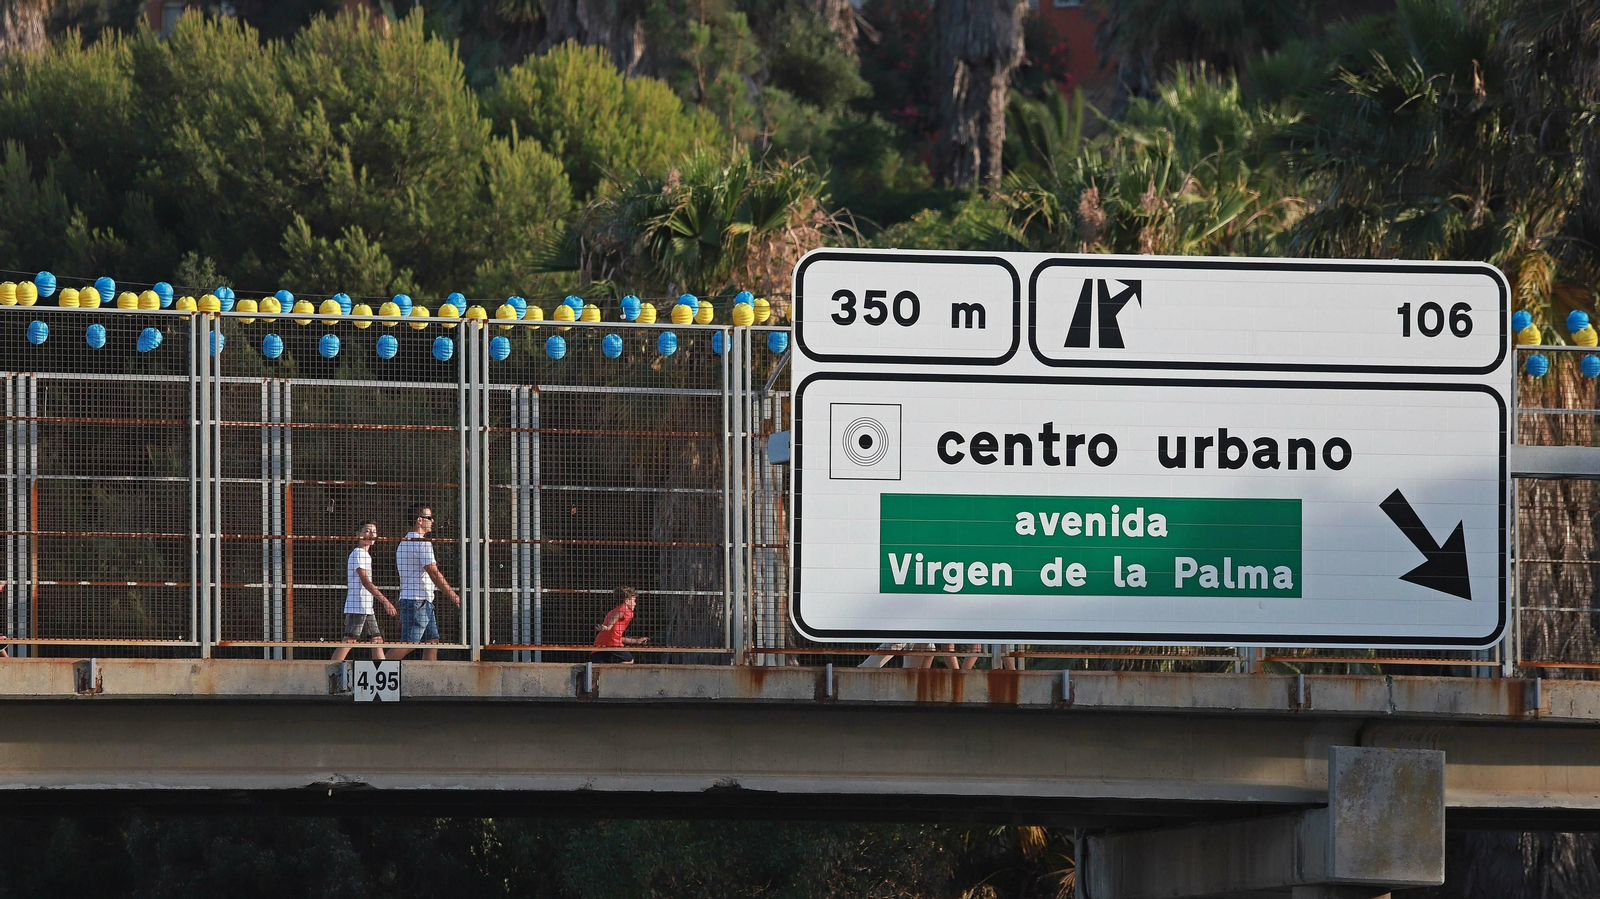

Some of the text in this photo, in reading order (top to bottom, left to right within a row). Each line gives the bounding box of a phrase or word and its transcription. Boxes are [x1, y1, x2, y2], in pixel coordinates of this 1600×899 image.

[830, 289, 986, 330] 350 m
[1397, 301, 1474, 339] 106
[936, 421, 1353, 471] centro urbano
[1015, 504, 1169, 538] avenida
[887, 552, 1294, 593] Virgen de la Palma
[357, 670, 399, 695] 4,95
